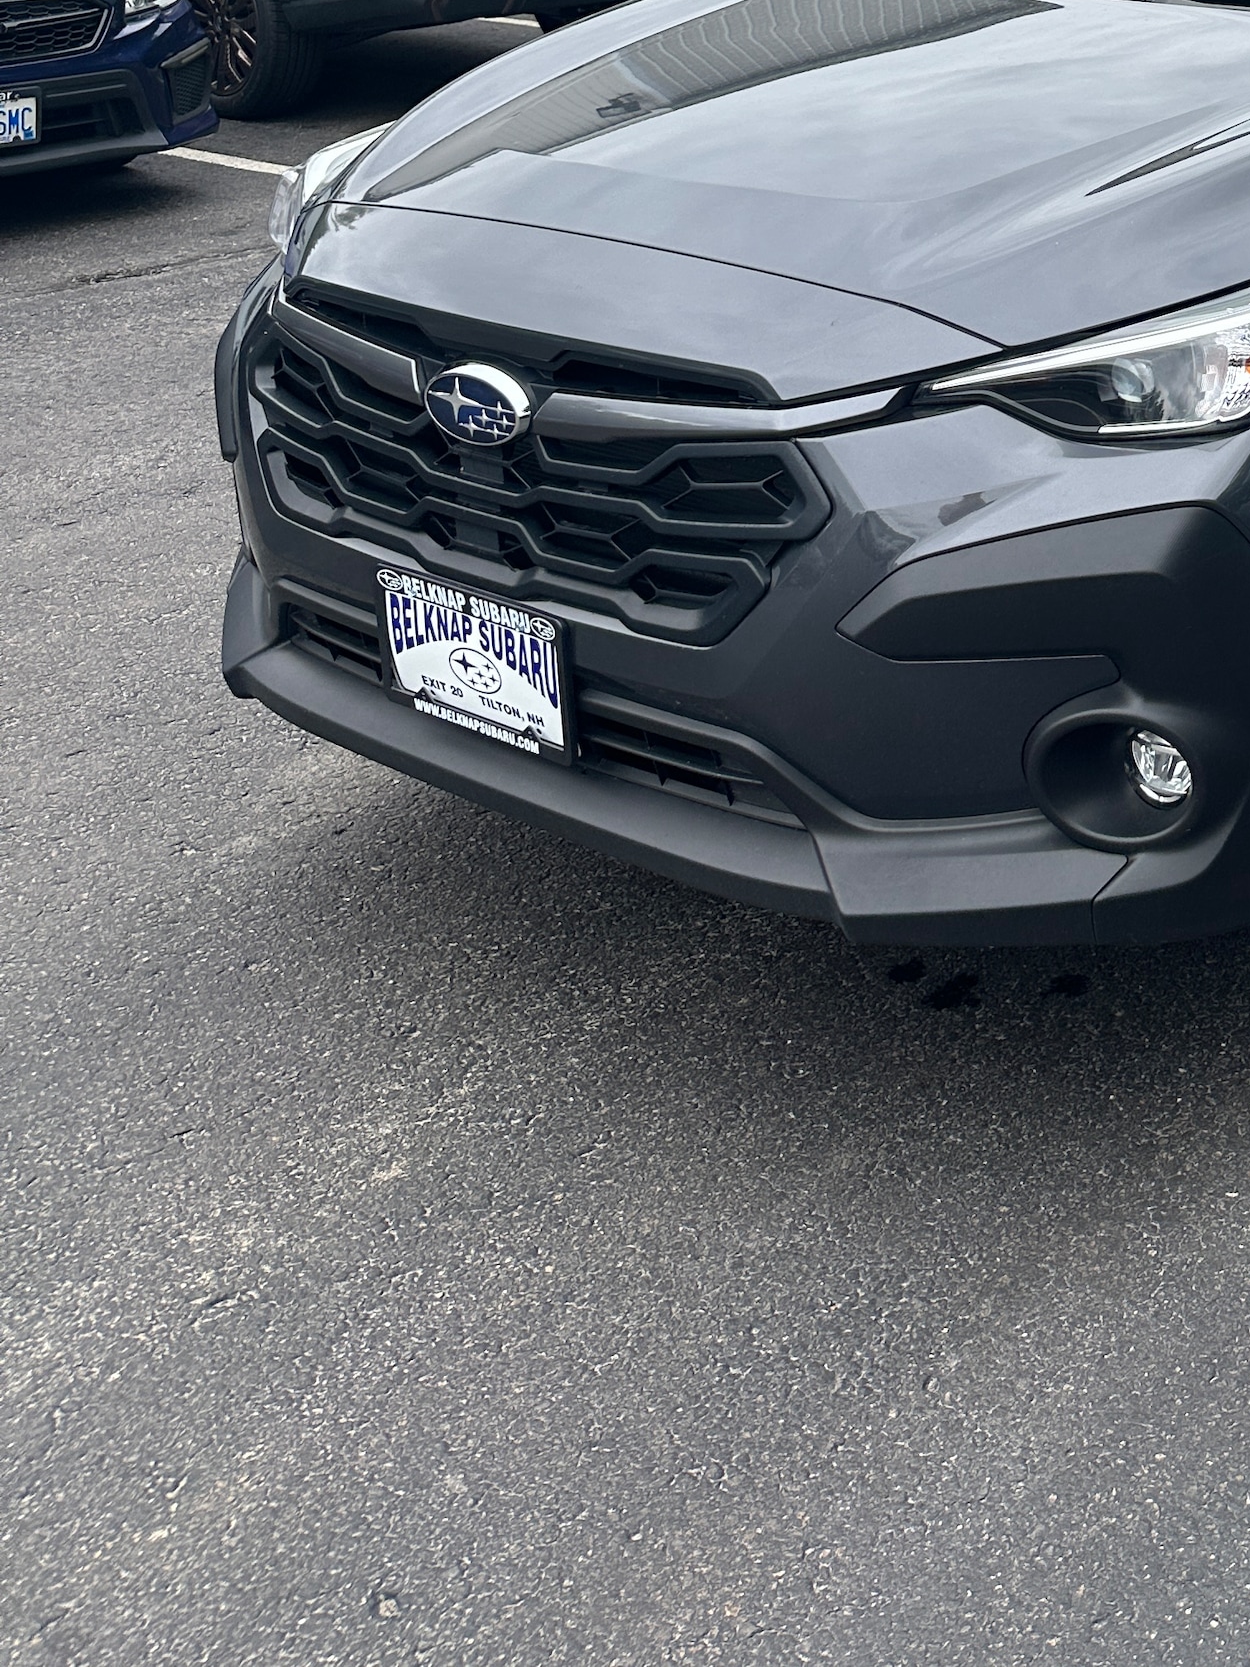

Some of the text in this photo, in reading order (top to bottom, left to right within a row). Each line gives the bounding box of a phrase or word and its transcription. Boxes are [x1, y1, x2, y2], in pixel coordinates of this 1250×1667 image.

[401, 574, 531, 633] BELKNAP SUBARU
[390, 592, 558, 709] BELKNAP SUBARU
[421, 675, 464, 698] EXIT 20
[479, 695, 545, 727] TILTON, NH
[413, 698, 540, 755] WWW.BELKNAPSUBARU.COM
